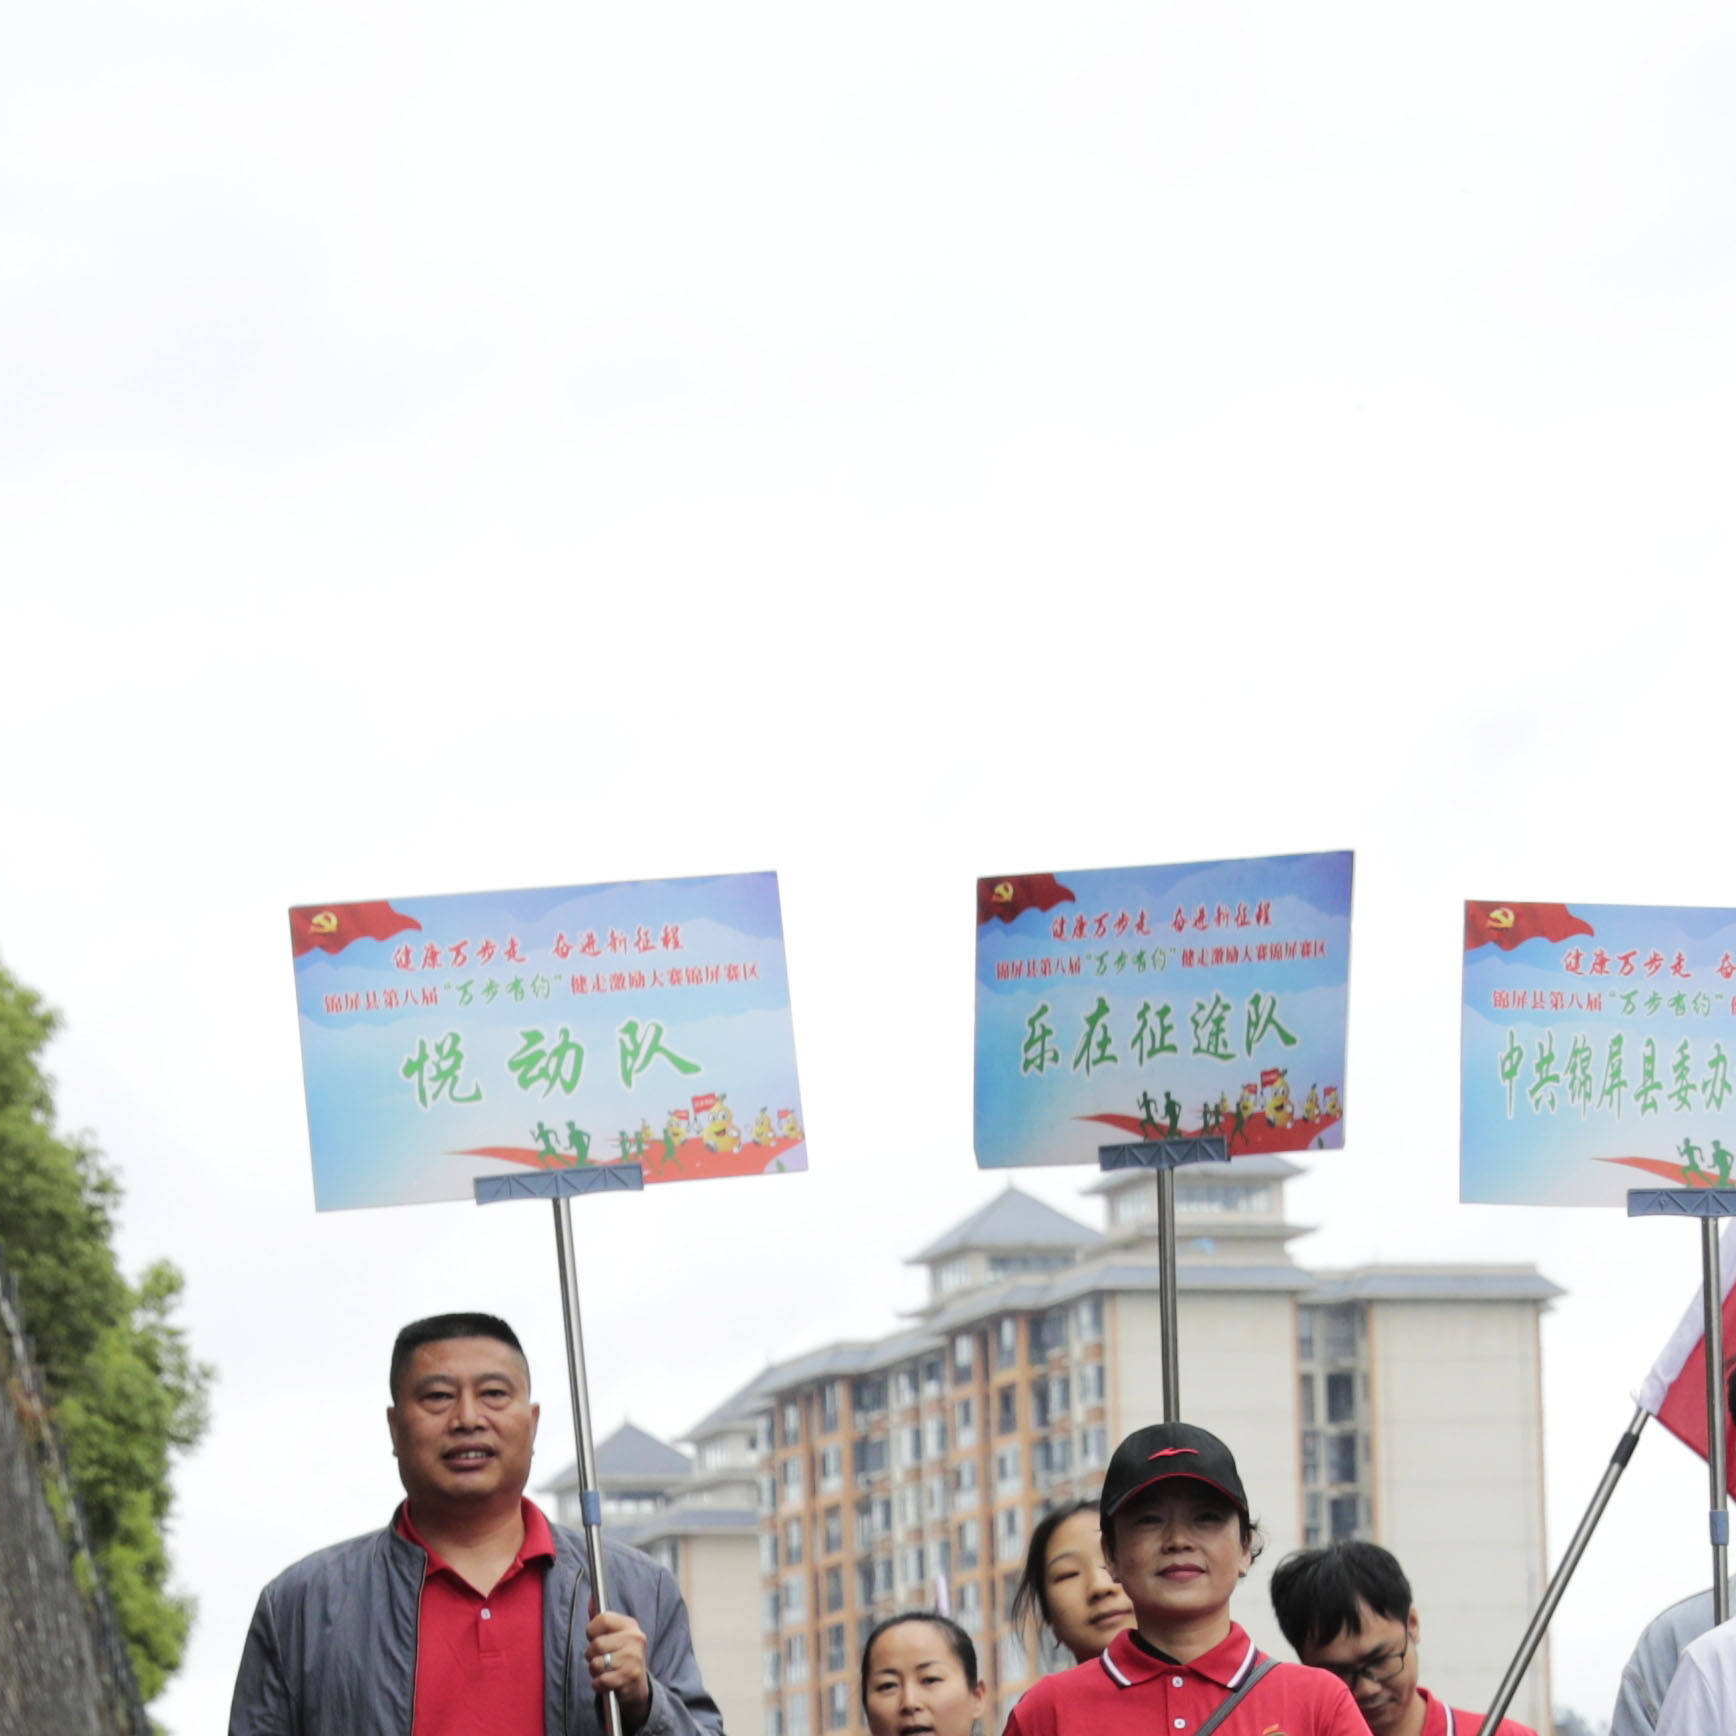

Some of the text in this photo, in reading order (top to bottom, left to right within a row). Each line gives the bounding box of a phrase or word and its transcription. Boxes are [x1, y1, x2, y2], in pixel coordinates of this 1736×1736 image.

[1051, 901, 1273, 942] 健康万步走 奋进新征程
[392, 923, 685, 974] 健康万步走 奋进新征程
[1561, 948, 1692, 980] 健康万步走
[1021, 989, 1298, 1077] 乐在征途队
[401, 1019, 703, 1110] 悦动队
